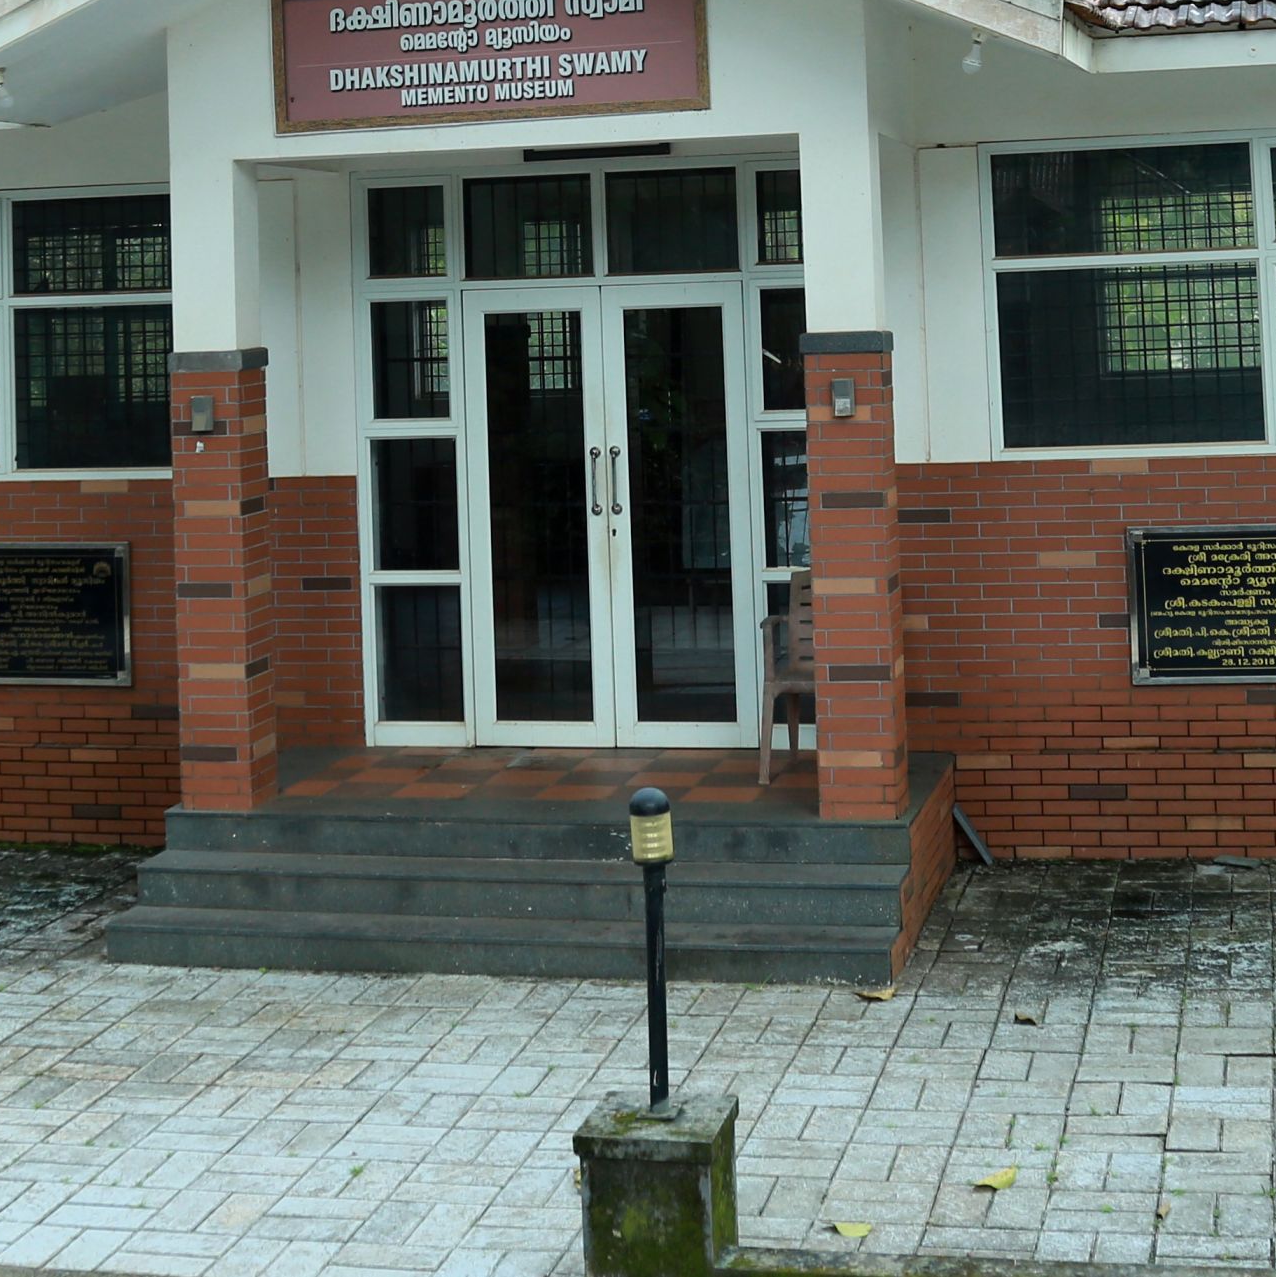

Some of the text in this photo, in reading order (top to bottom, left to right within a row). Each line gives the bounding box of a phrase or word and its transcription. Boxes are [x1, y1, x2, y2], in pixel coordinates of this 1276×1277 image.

[400, 20, 572, 53] മെമന്റോ മ്യൂസിയം
[329, 49, 647, 92] DHAKSHINAMURTHI SWAMY
[401, 79, 573, 107] MEMENTO MUSEUM
[1222, 658, 1275, 666] 28.12.2018
